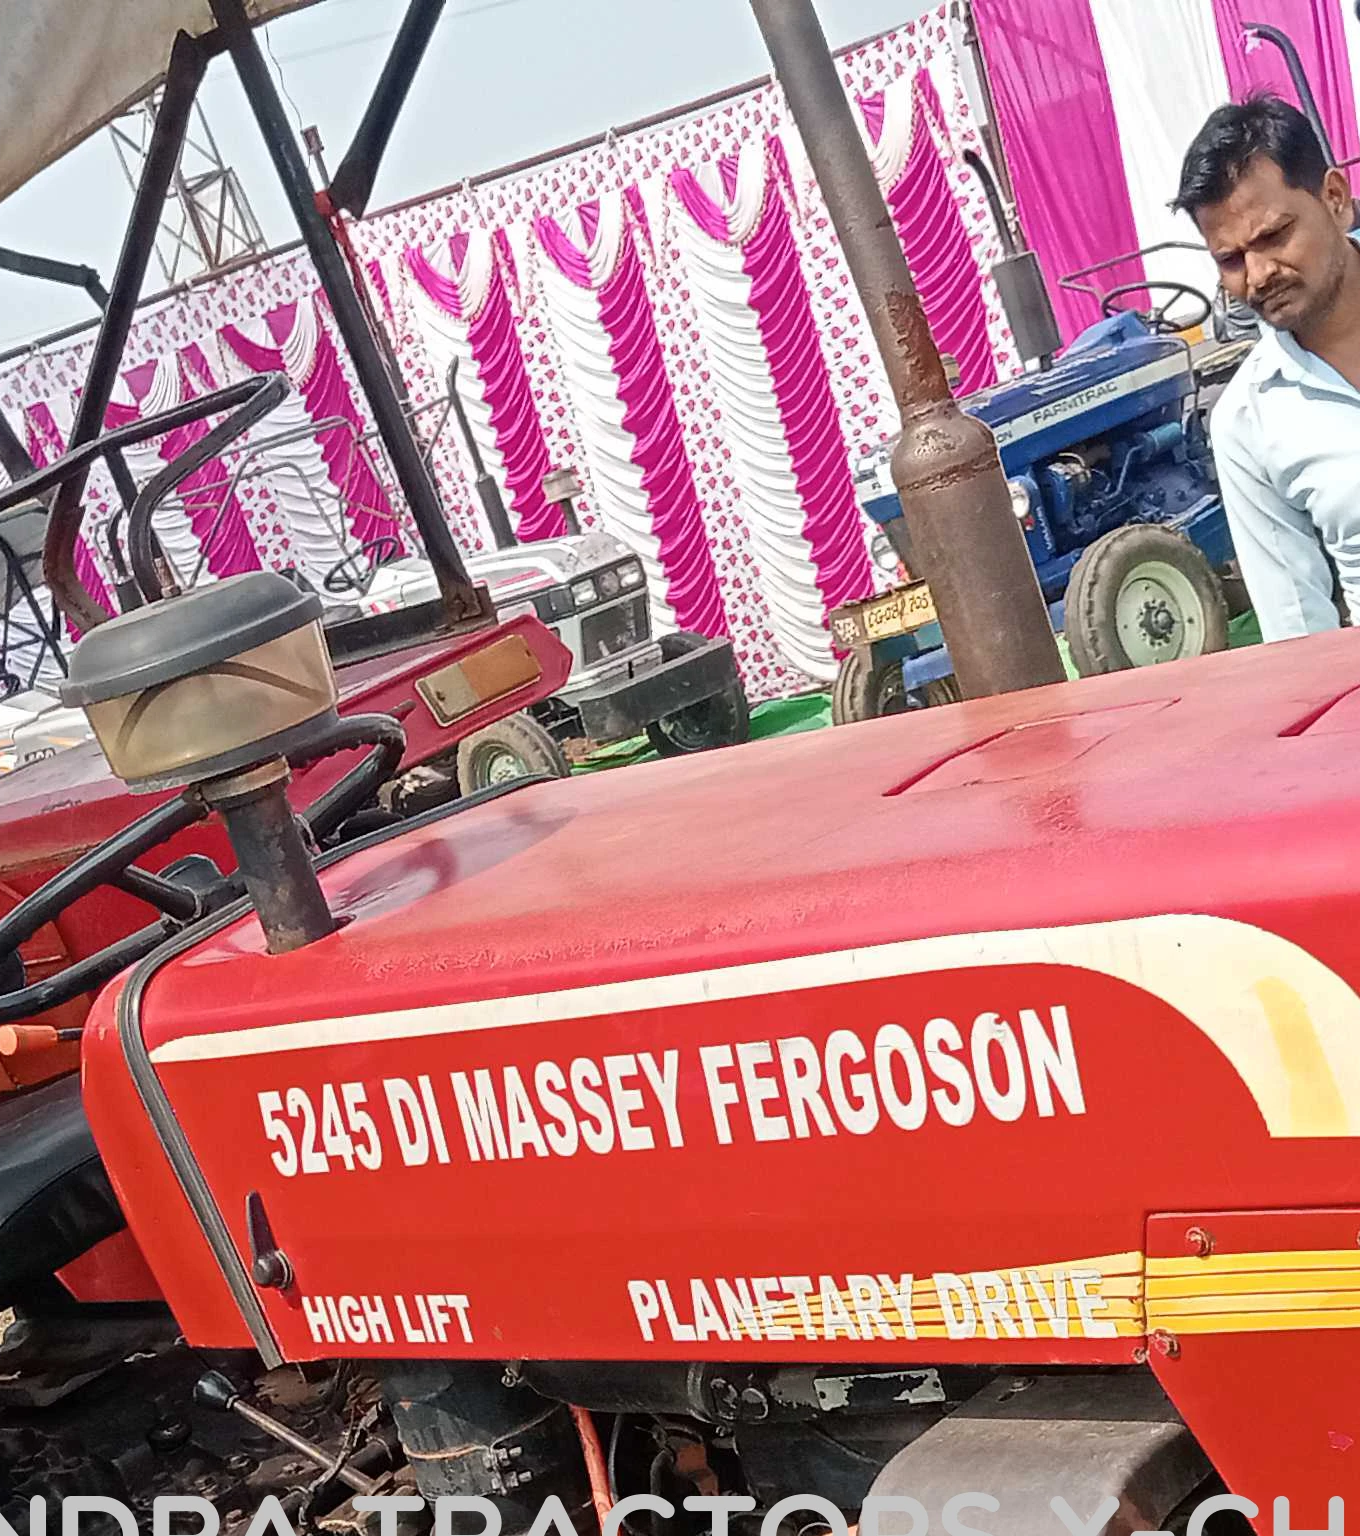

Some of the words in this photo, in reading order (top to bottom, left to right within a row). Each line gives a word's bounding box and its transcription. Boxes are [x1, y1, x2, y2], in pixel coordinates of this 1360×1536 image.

[257, 1081, 383, 1178] 5245
[383, 1075, 451, 1167] DI
[451, 1049, 684, 1162] MASSEY
[699, 1005, 1086, 1145] FERGOSON
[301, 1295, 395, 1343] HIGH
[397, 1294, 474, 1343] LIFT
[627, 1272, 918, 1342] PLANETARY
[931, 1269, 1119, 1341] DRIVE
